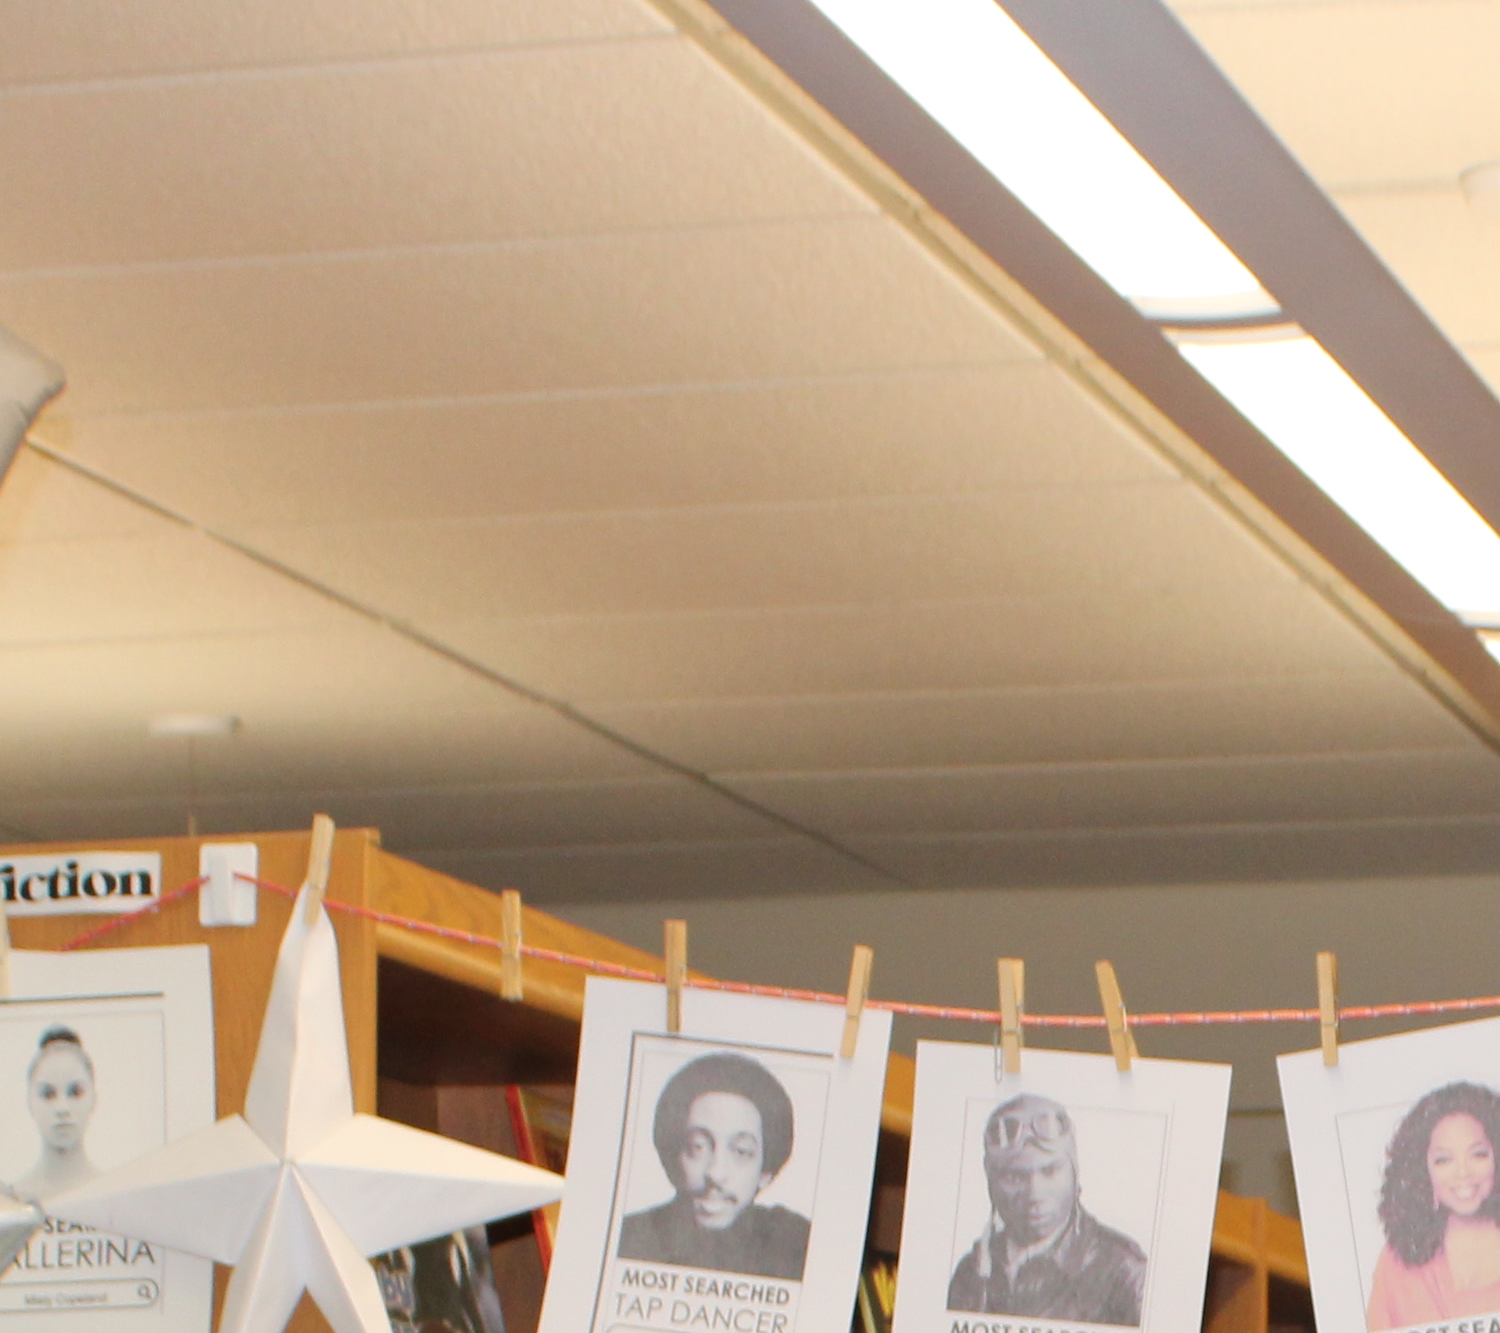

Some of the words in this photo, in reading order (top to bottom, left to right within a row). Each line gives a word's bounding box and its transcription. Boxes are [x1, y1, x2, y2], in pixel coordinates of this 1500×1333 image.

[13, 1237, 156, 1270] LLERINA
[622, 1269, 679, 1291] MOST
[684, 1275, 790, 1305] SEARCHED
[615, 1292, 662, 1320] TAP
